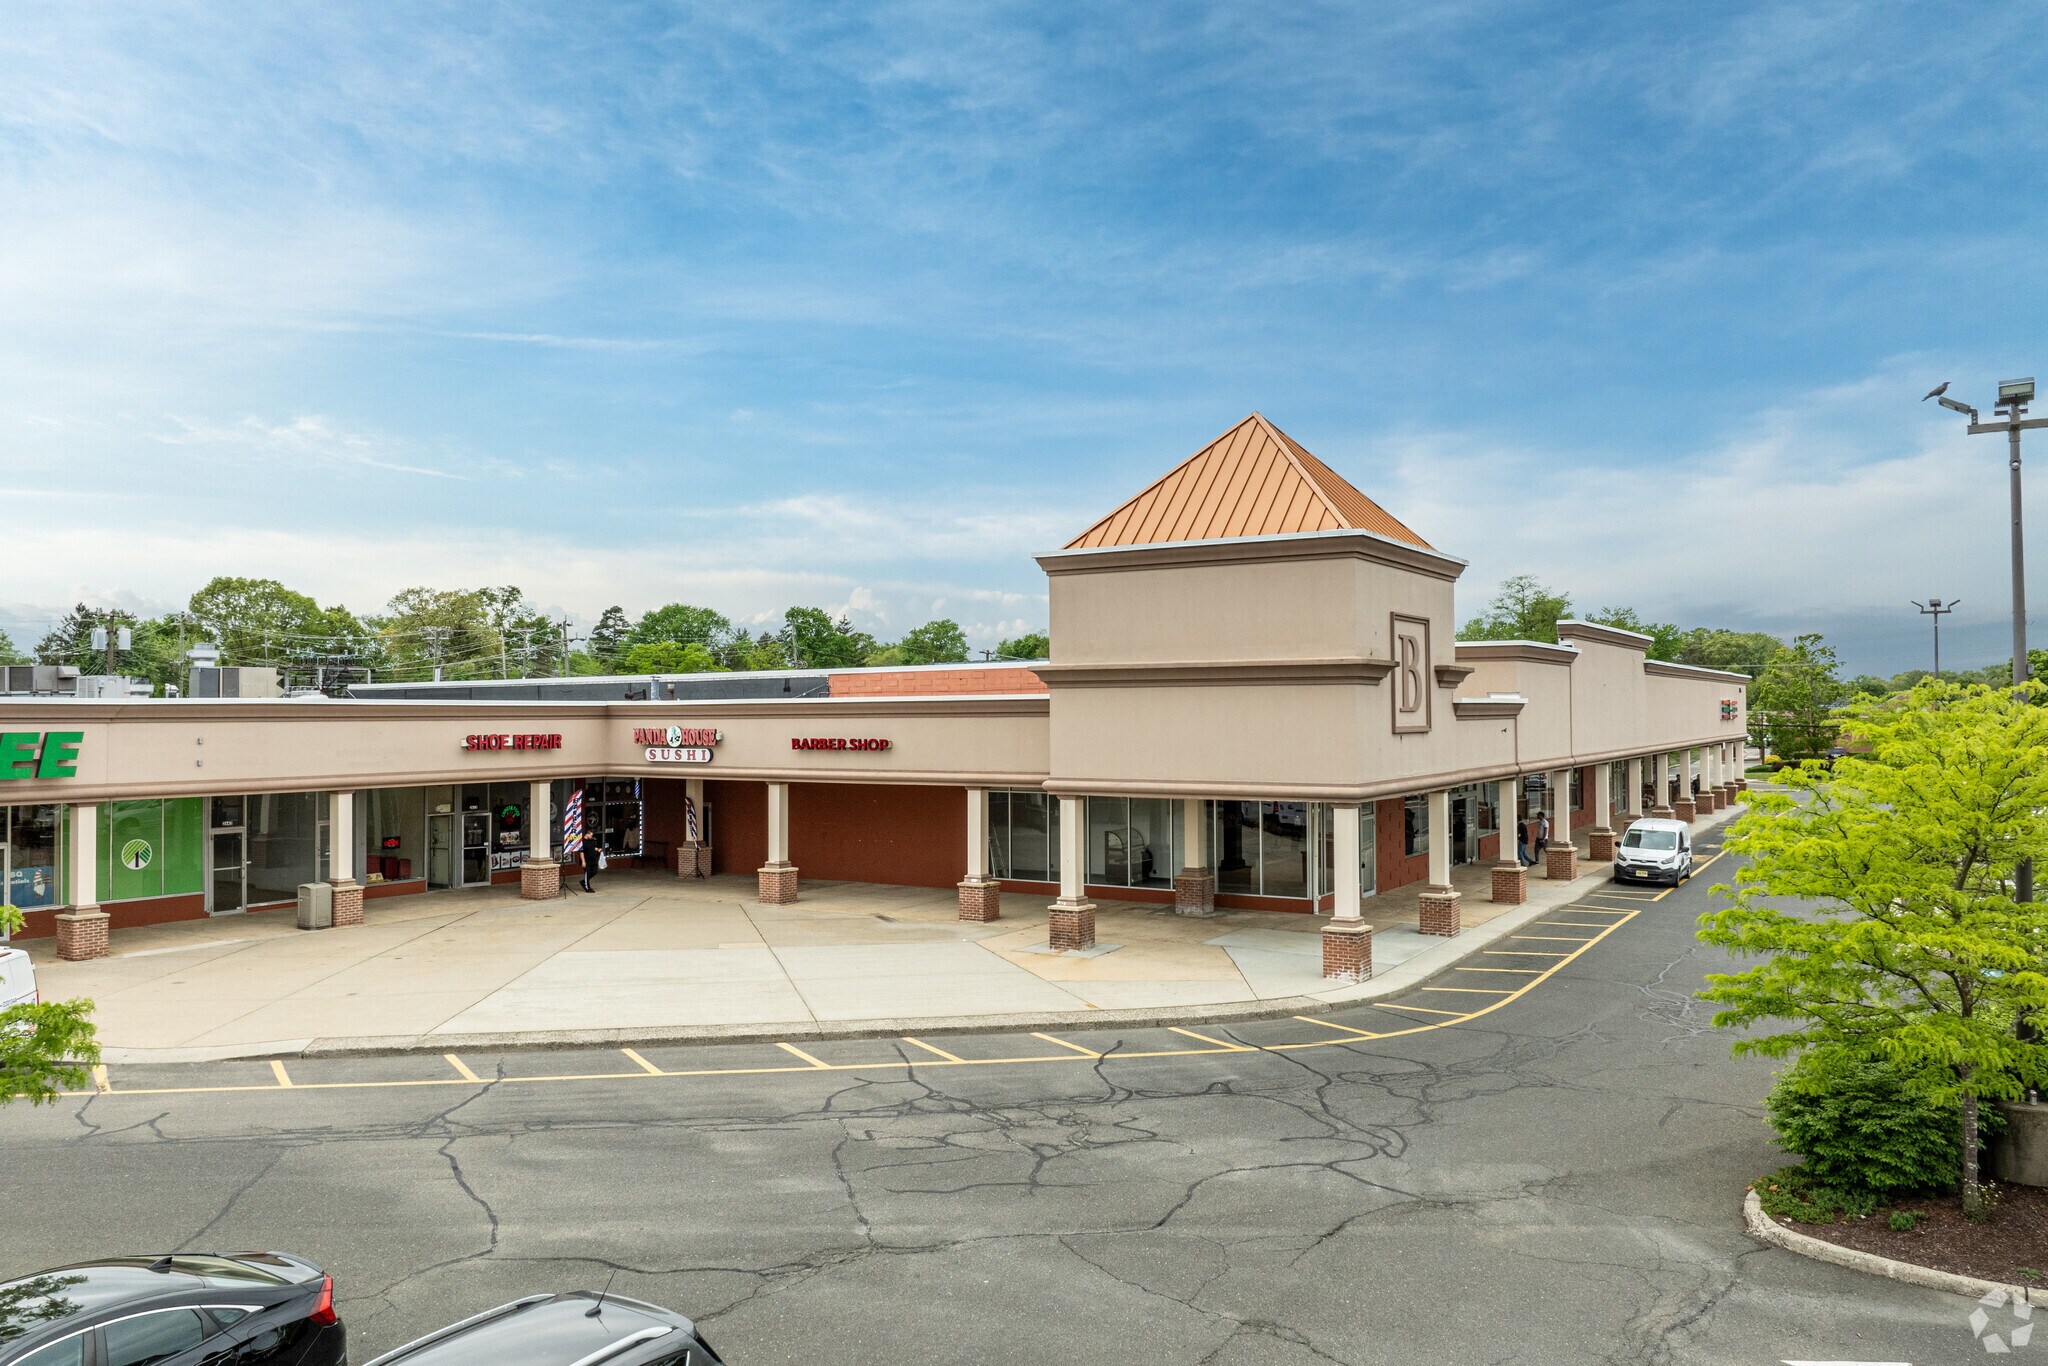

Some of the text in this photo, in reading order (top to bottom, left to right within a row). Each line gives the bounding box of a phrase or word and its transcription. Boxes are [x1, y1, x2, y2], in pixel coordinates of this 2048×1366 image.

[1398, 634, 1422, 712] B
[466, 734, 562, 751] SHOE REPAIR
[633, 728, 716, 746] PANDA HOUSE
[791, 738, 889, 751] BARBER SHOP
[648, 749, 707, 760] SUSHI
